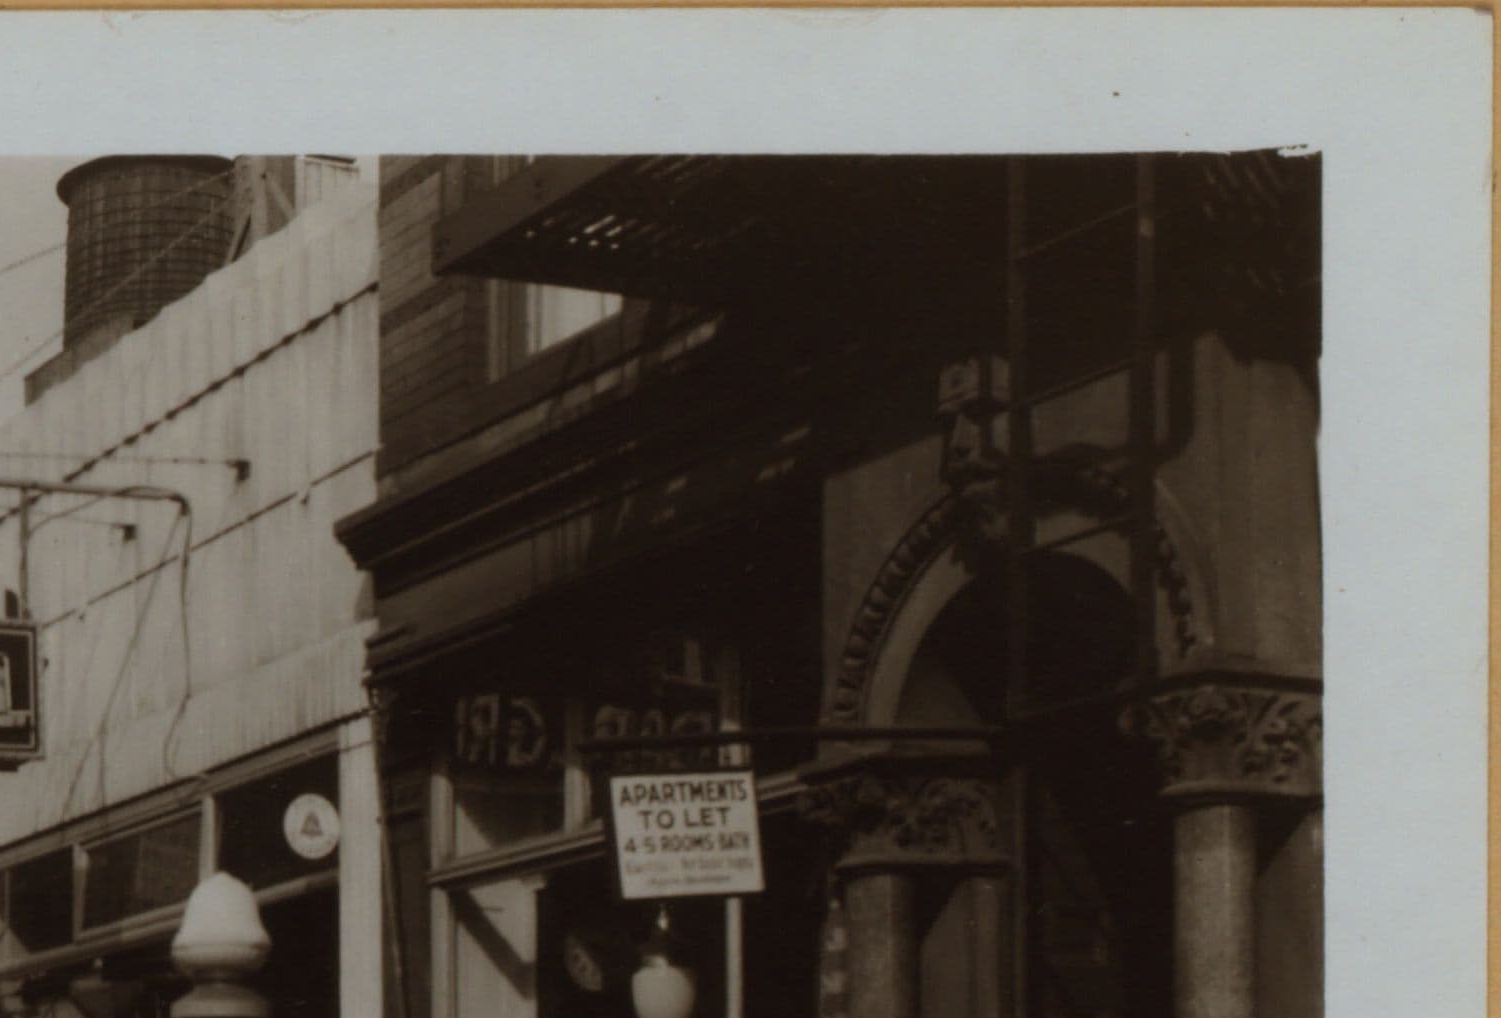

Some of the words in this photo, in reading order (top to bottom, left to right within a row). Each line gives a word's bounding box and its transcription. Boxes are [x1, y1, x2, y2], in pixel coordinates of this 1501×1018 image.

[619, 779, 748, 808] APARTMENTS
[637, 809, 675, 830] TO
[683, 806, 731, 828] LET
[660, 834, 714, 852] ROOMS
